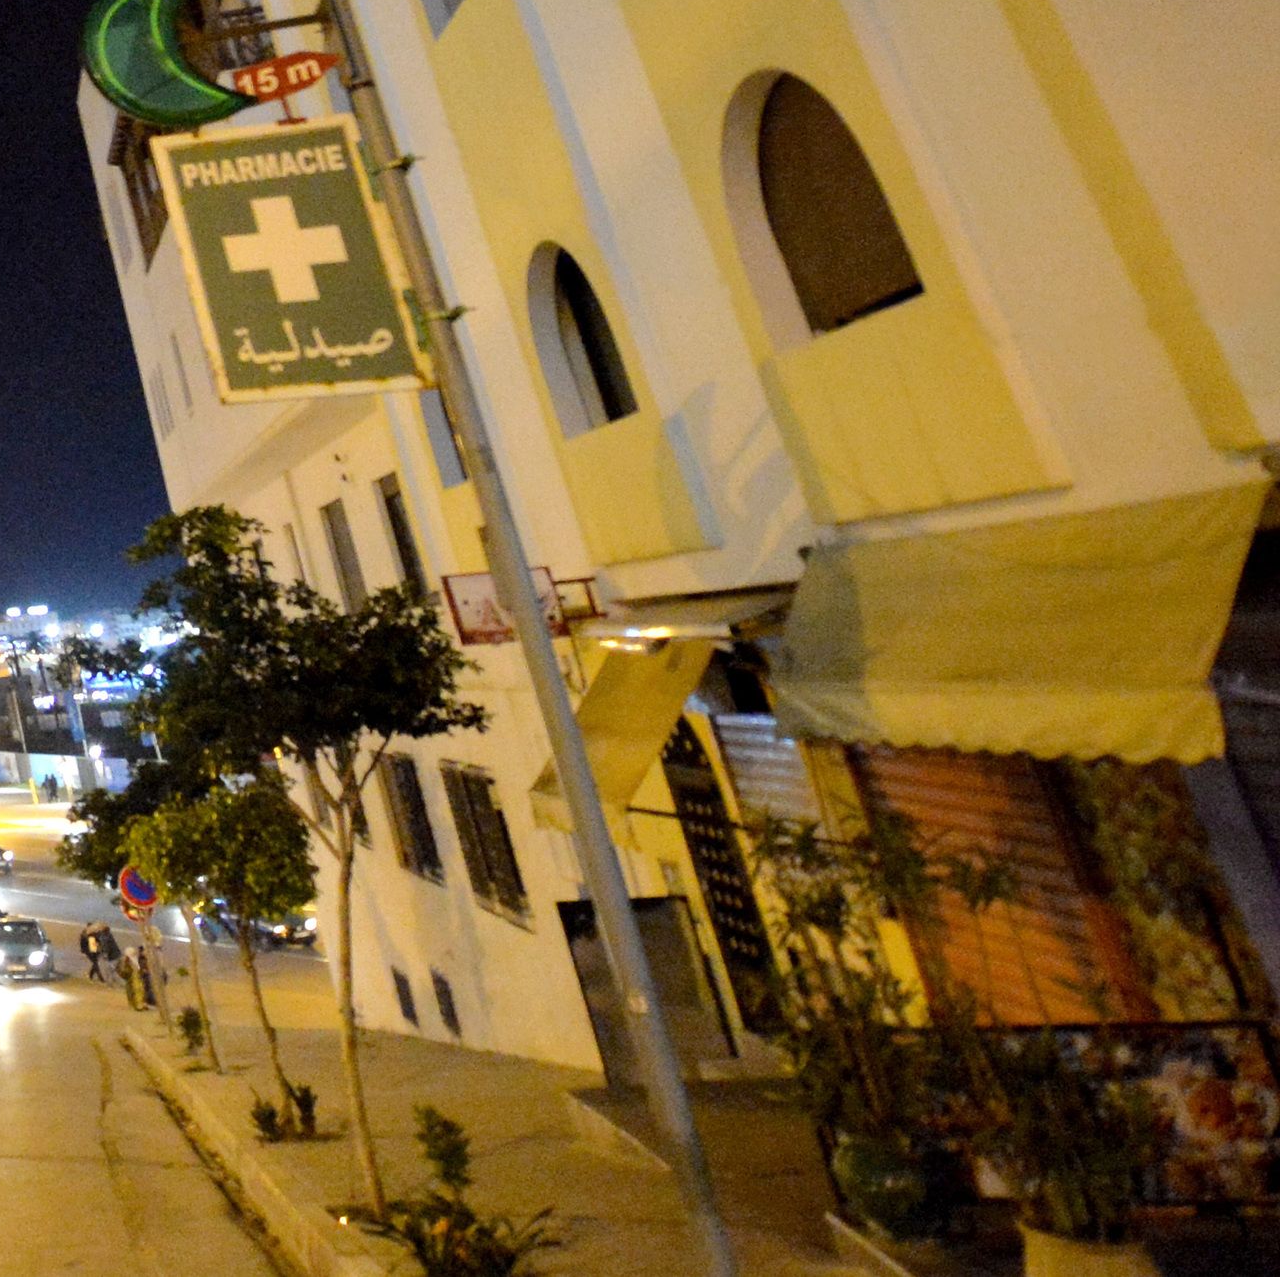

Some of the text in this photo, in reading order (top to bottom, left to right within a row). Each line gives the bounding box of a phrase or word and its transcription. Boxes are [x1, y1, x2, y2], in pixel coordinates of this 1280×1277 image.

[237, 59, 322, 96] 15 m
[181, 145, 347, 187] PHARMACIE
[234, 319, 394, 372] صيدلية
